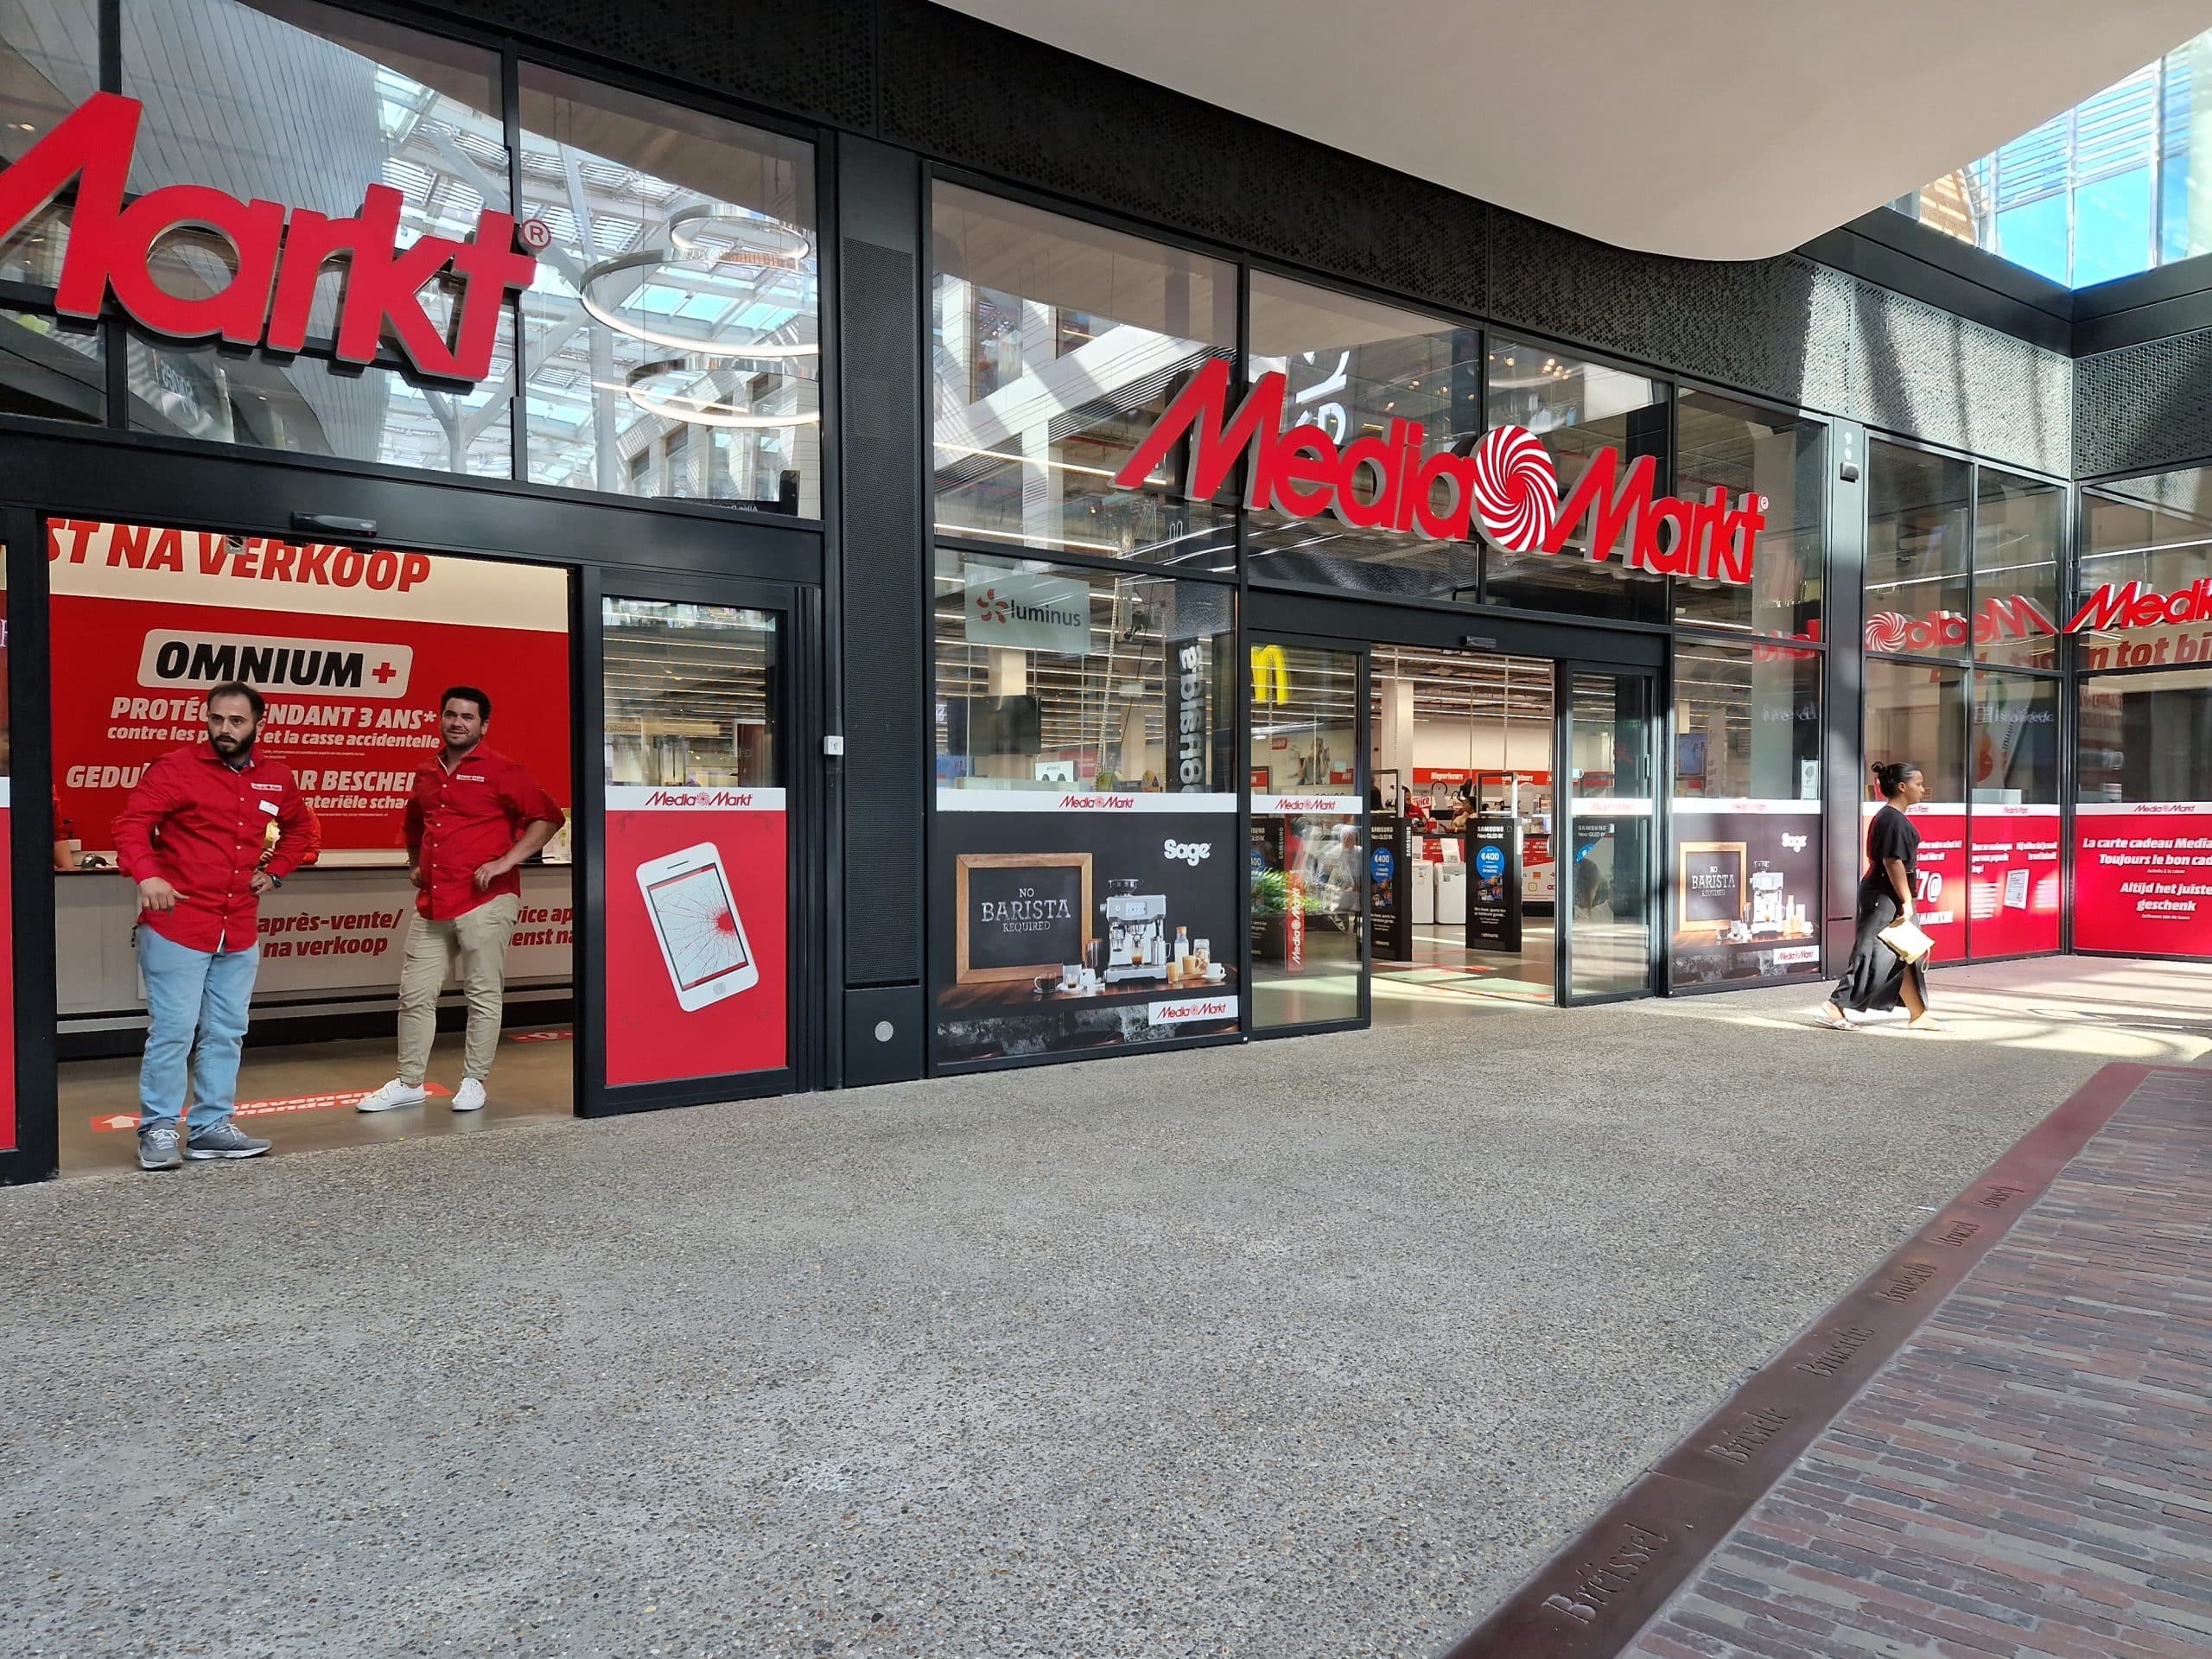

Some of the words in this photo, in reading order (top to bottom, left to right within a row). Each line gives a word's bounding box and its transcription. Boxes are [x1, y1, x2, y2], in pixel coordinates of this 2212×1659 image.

[1109, 357, 1474, 541] Media
[1542, 446, 1768, 585] Markt
[106, 524, 183, 572] NA
[198, 532, 430, 592] VERKOOP
[1011, 601, 1081, 627] luminus
[2116, 637, 2170, 669] tot
[156, 641, 364, 688] OMNIUM
[358, 708, 372, 728] 3
[107, 725, 166, 741] contre
[170, 726, 195, 741] les
[264, 731, 281, 744] et
[283, 730, 298, 744] la
[302, 734, 344, 746] casse
[346, 733, 440, 749] accidentelle
[645, 791, 697, 806] Media
[709, 791, 753, 806] Markt
[1058, 795, 1095, 808] Media
[1103, 795, 1135, 809] Markt
[1274, 798, 1304, 810] Media
[1310, 798, 1336, 810] Markt
[2133, 804, 2162, 812] Media
[2082, 838, 2096, 849] La
[2096, 838, 2128, 849] carte
[2128, 837, 2174, 849] cadeau
[1163, 839, 1211, 867] Sage
[1481, 852, 1500, 861] €400
[2099, 854, 2152, 866] Toujours
[2152, 854, 2164, 865] le
[2165, 855, 2190, 866] bon
[1691, 874, 1736, 889] BARISTA
[2120, 881, 2155, 894] Altijd
[2155, 881, 2177, 893] het
[2176, 883, 2212, 896] juiste
[1020, 887, 1034, 898] NO
[982, 899, 1071, 922] BARISTA
[2136, 899, 2196, 912] geschenk
[257, 908, 404, 936] après-vente/
[1002, 921, 1051, 933] REQUIRED
[263, 942, 293, 958] na
[296, 935, 388, 957] verkoop
[1157, 1003, 1190, 1019] Media
[1198, 1002, 1226, 1015] Markt
